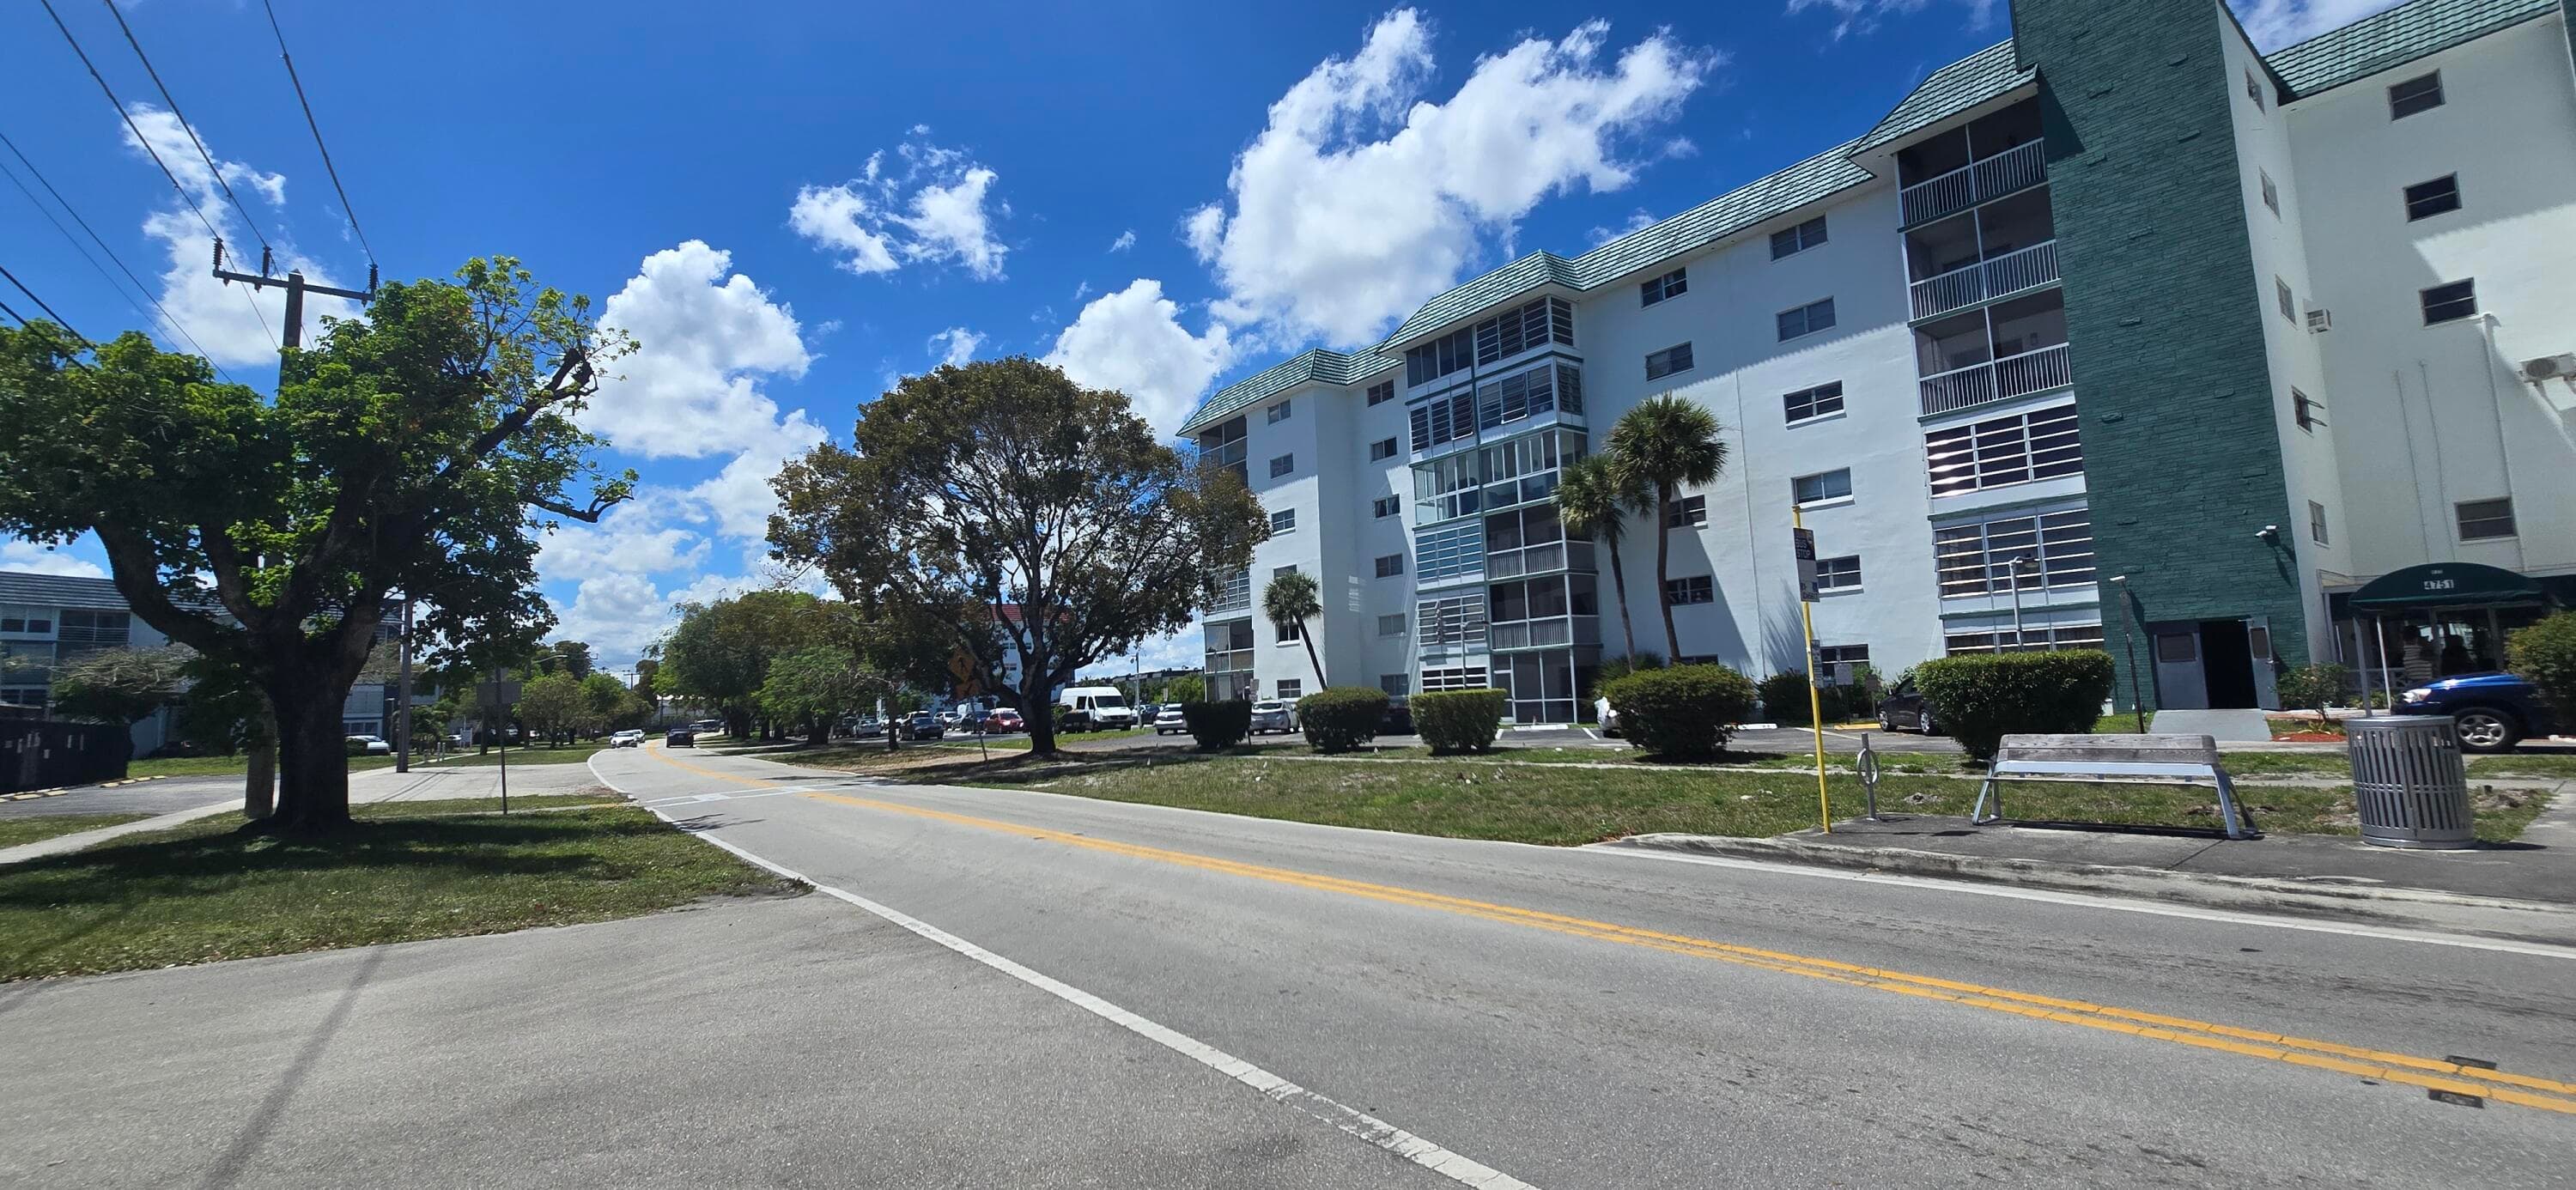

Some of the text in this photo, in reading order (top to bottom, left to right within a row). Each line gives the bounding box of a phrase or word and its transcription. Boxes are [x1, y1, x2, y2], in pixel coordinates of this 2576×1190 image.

[1795, 538, 1807, 548] BUS
[1796, 549, 1811, 558] STOP
[2424, 580, 2453, 590] 4751
